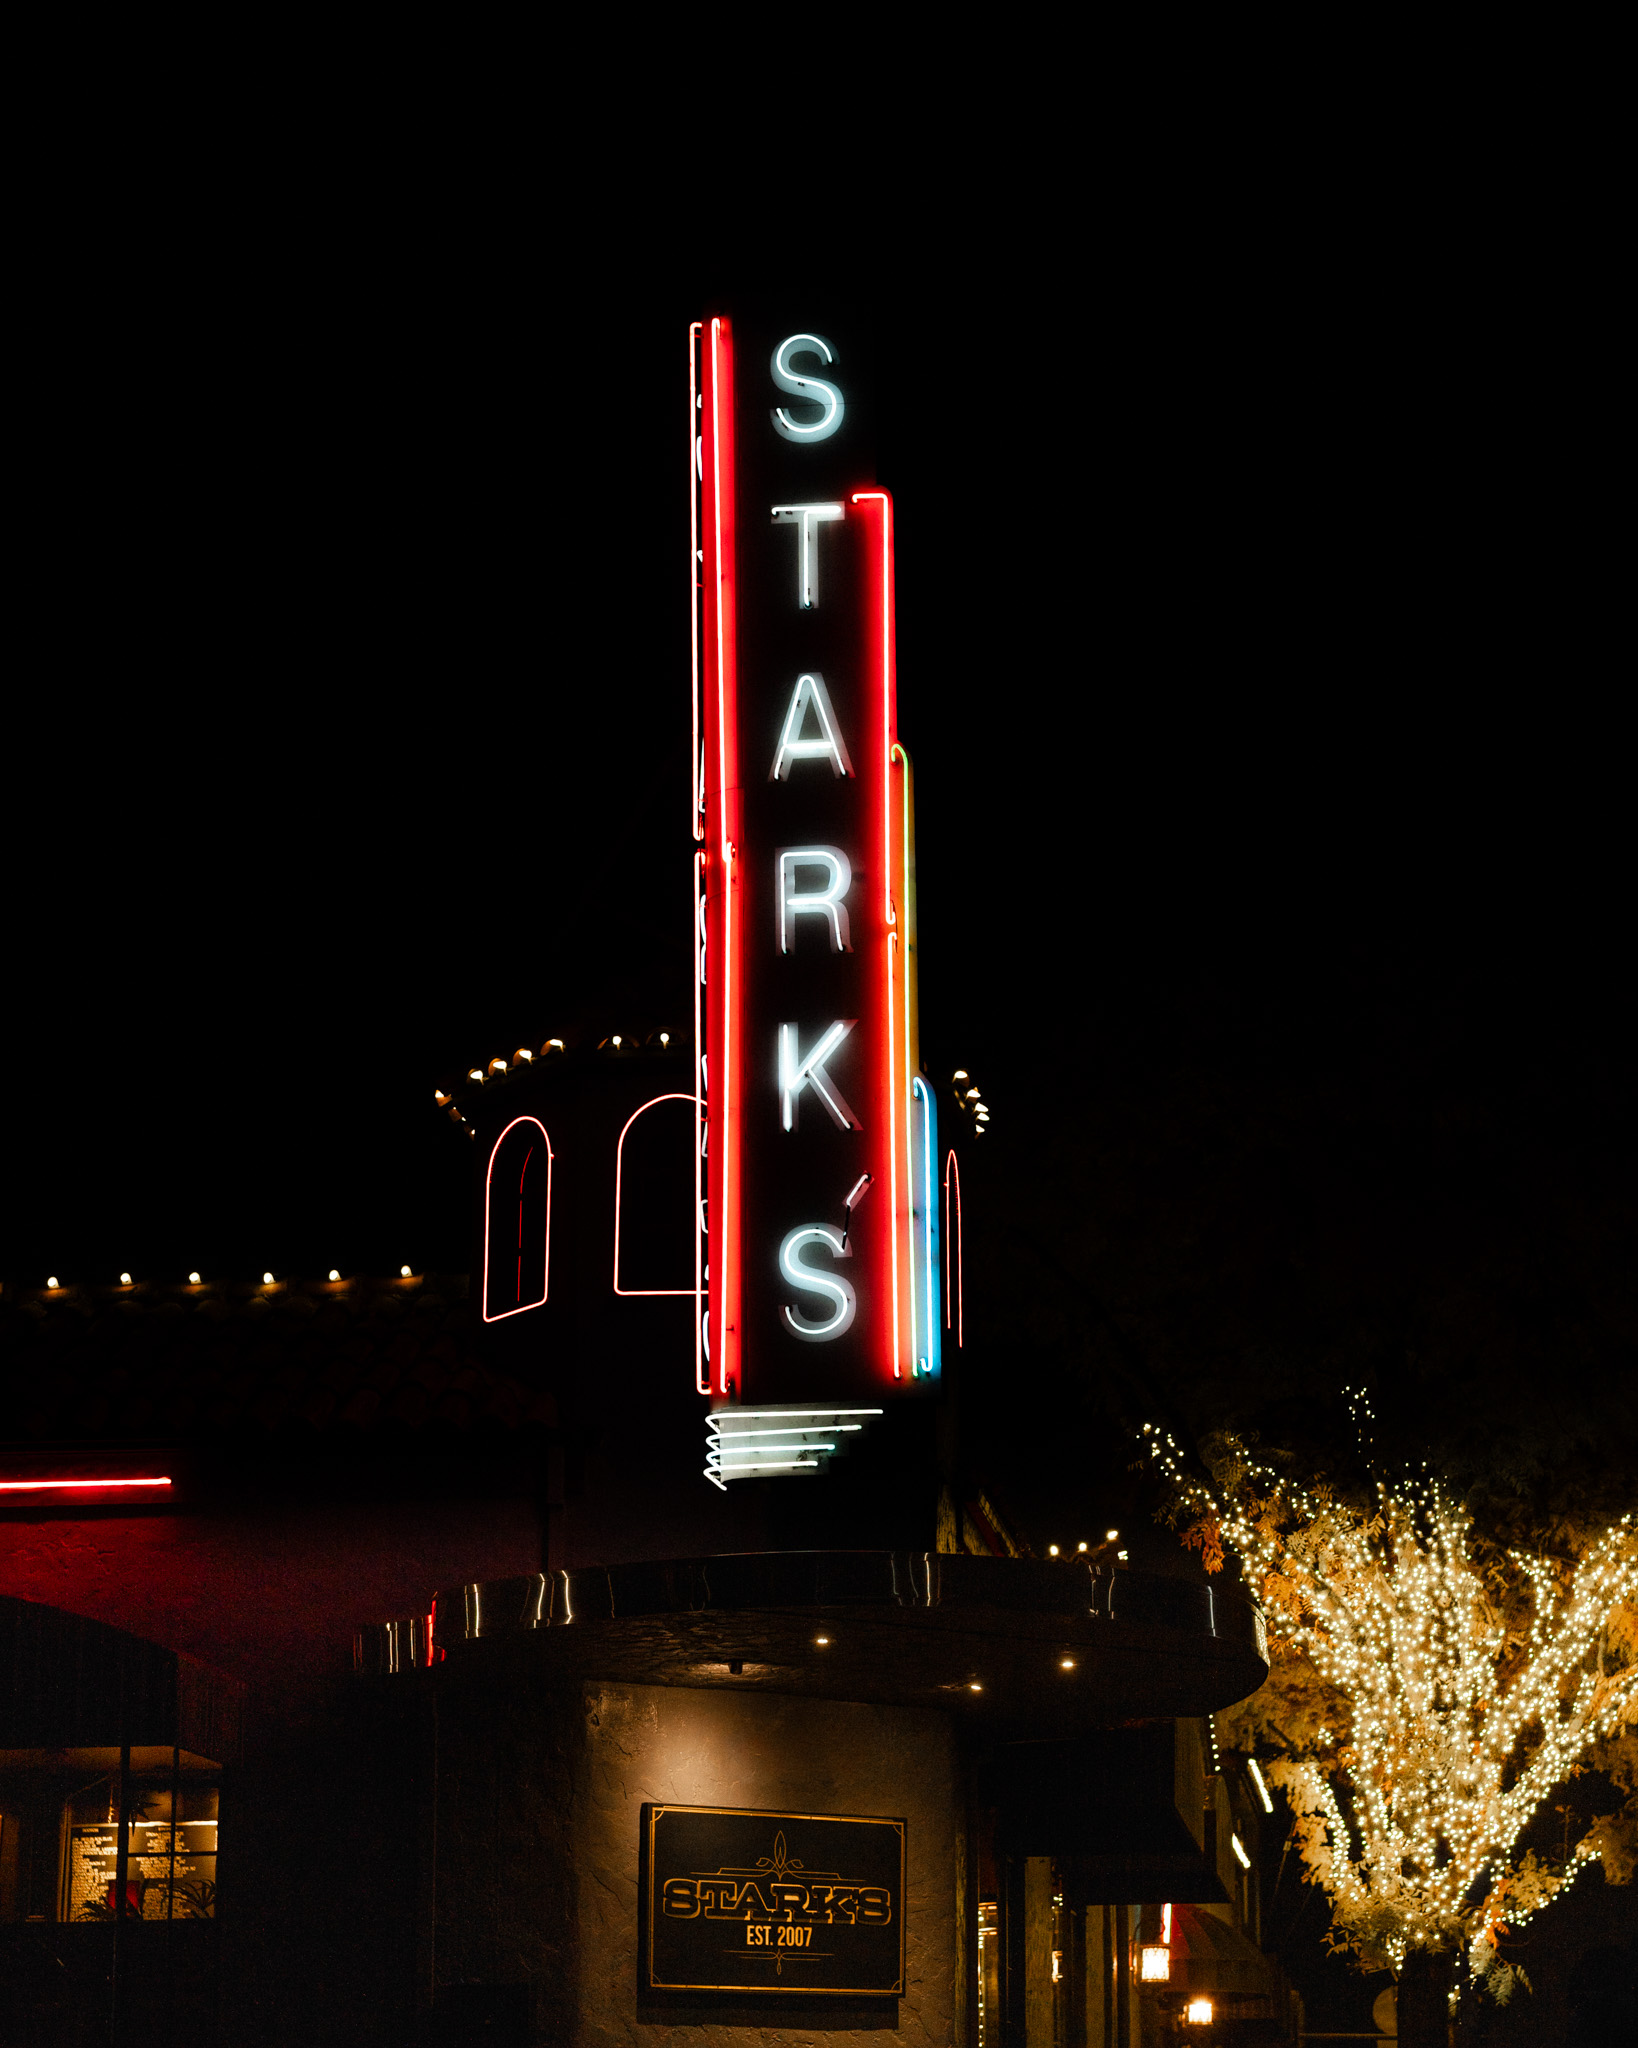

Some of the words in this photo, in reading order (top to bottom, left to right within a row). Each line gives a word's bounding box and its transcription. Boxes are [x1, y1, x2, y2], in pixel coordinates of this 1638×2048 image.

[769, 333, 873, 1343] STARK'S
[746, 1926, 774, 1946] EST.
[777, 1926, 813, 1948] 2007
